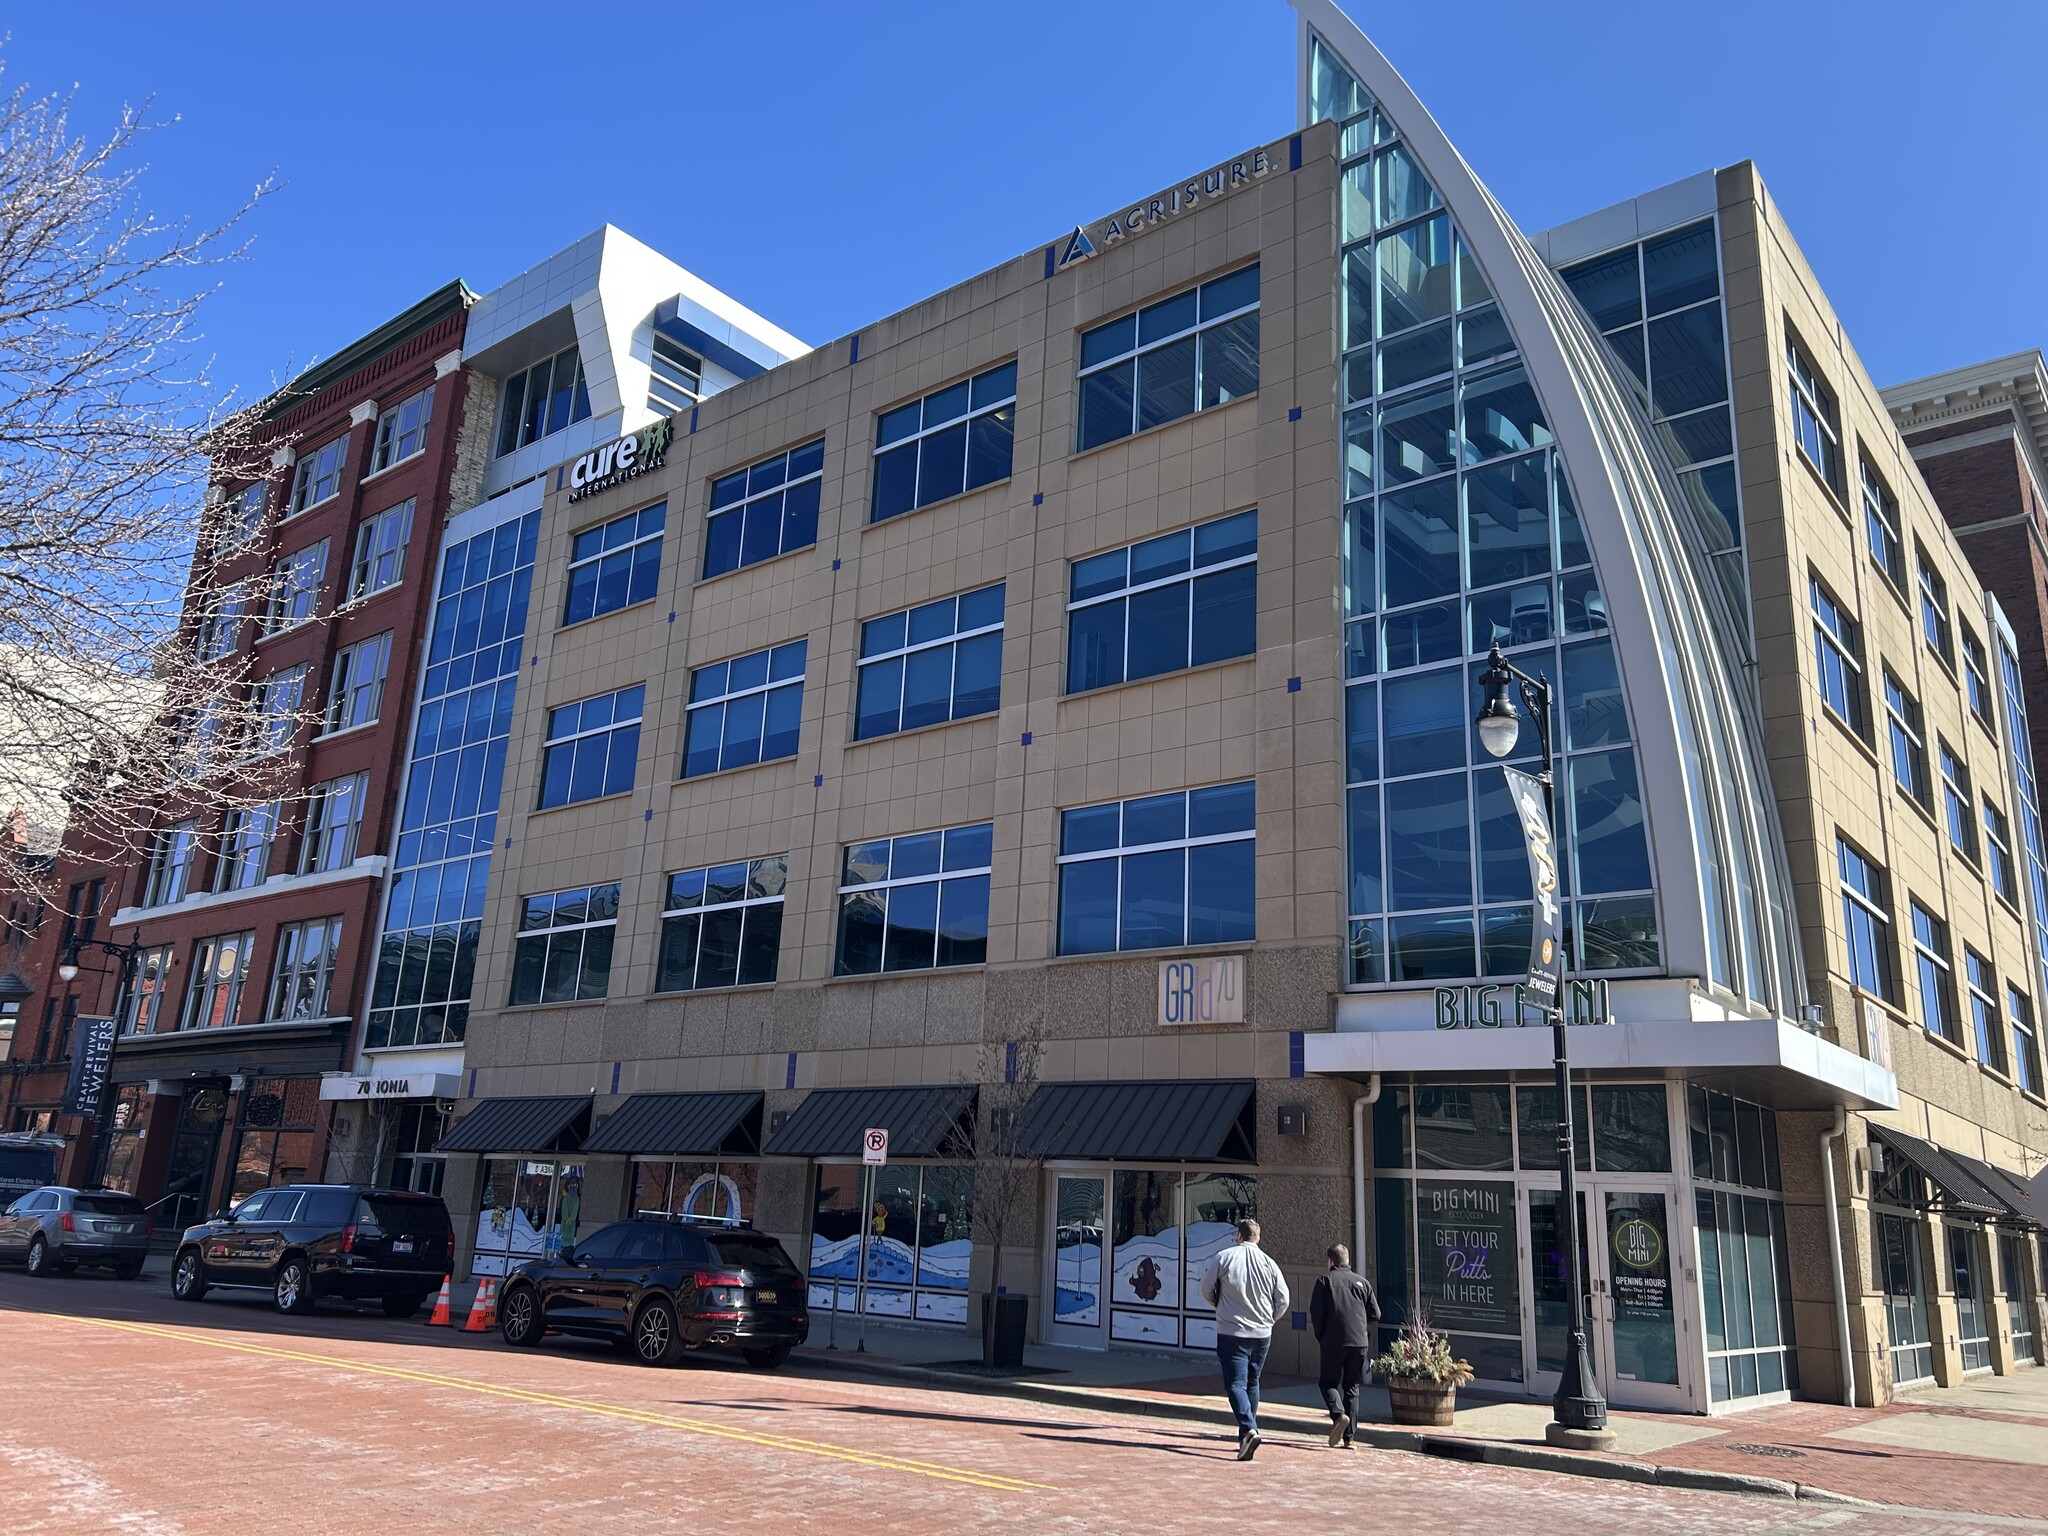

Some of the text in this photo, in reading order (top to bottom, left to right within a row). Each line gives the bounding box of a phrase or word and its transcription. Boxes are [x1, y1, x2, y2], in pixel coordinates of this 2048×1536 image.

[570, 435, 639, 489] cure
[567, 457, 664, 504] INTERNATIONAL
[1528, 976, 1556, 996] JEWELERS
[1434, 984, 1501, 1029] BIG
[76, 1024, 98, 1110] CRAFT-REVIVAL
[84, 1020, 114, 1116] JEWELERS
[357, 1079, 409, 1095] 70 IONIA
[1433, 1188, 1500, 1215] BIG MINI
[1435, 1229, 1499, 1250] GET YOUR
[1629, 1219, 1646, 1249] BIG
[1445, 1250, 1492, 1280] Putts
[1628, 1248, 1650, 1262] MINI
[1443, 1283, 1495, 1305] IN HERE
[1615, 1275, 1667, 1288] OPENING HOURS
